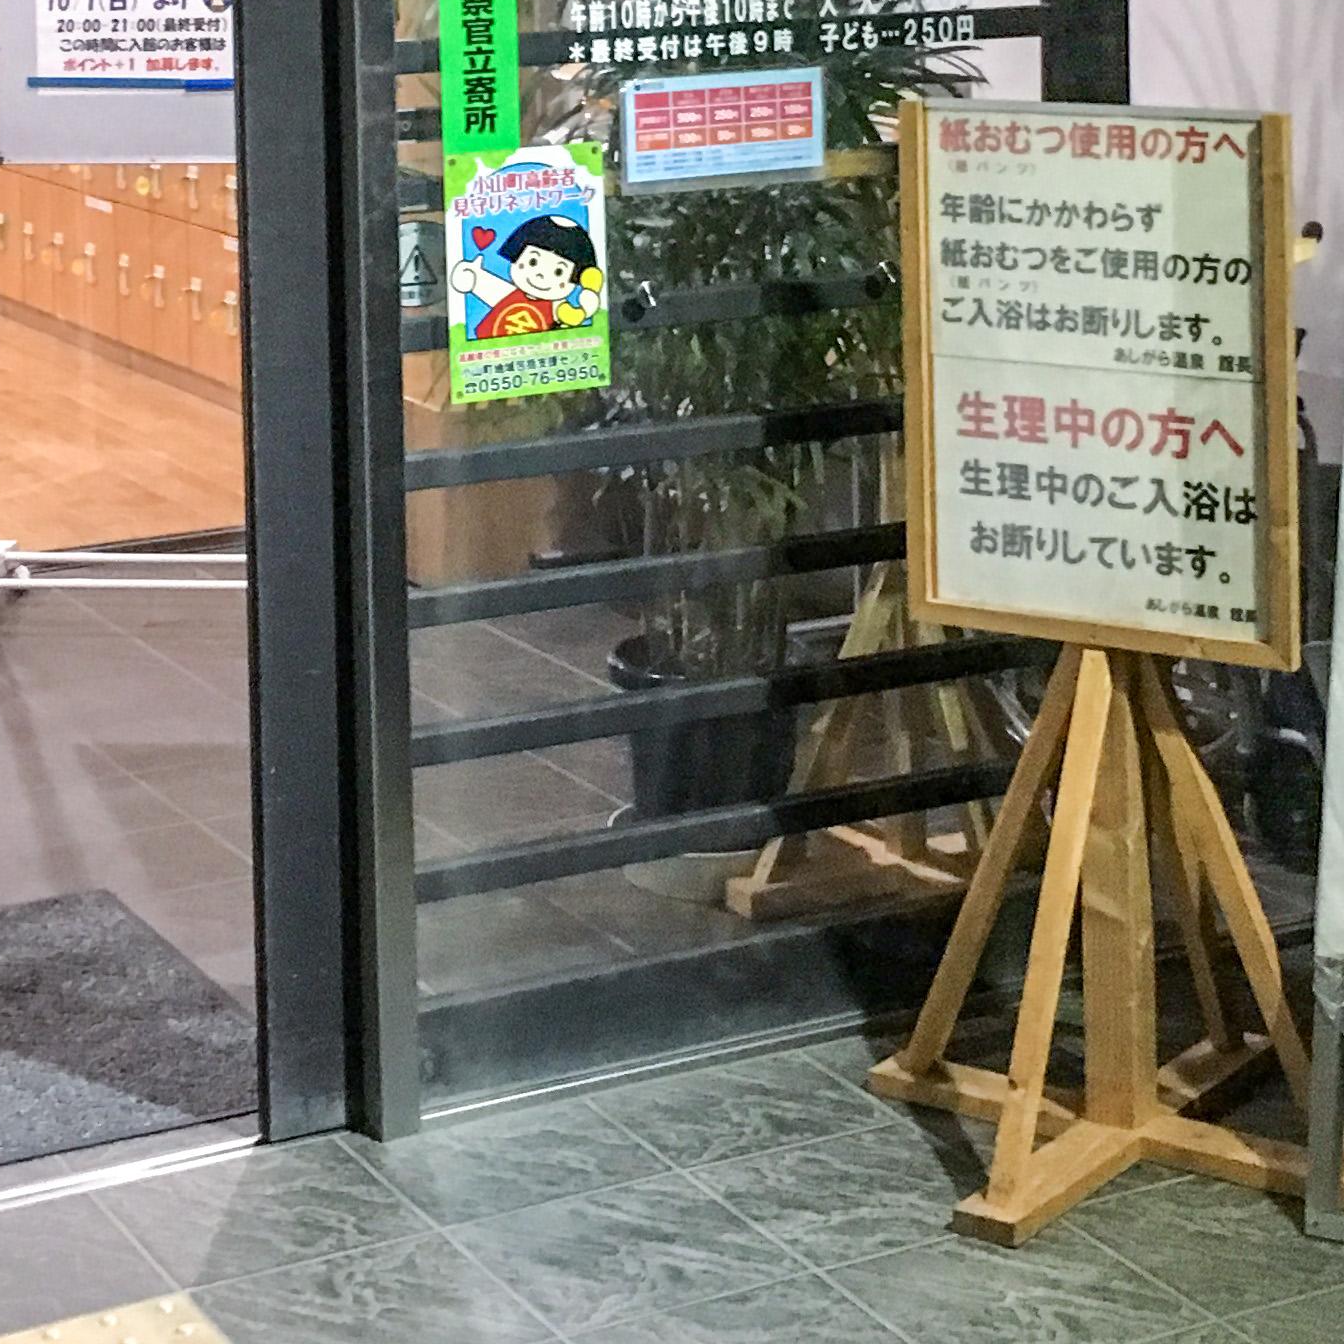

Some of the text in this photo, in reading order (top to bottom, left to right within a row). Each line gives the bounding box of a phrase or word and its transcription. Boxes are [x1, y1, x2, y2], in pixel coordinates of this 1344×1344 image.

[939, 117, 1247, 164] 紙おむつ使用の方へ
[454, 186, 596, 216] 見守りネットワーク
[940, 192, 1162, 232] 年齢にかかわらず
[940, 238, 1253, 285] 紙おむつをご使用の方の
[941, 296, 1223, 346] ご入浴はお断りします。
[956, 390, 1245, 459] 生理中の方へ
[959, 458, 1258, 524] 生理中のご入浴は
[969, 521, 1231, 584] お断りしています。
